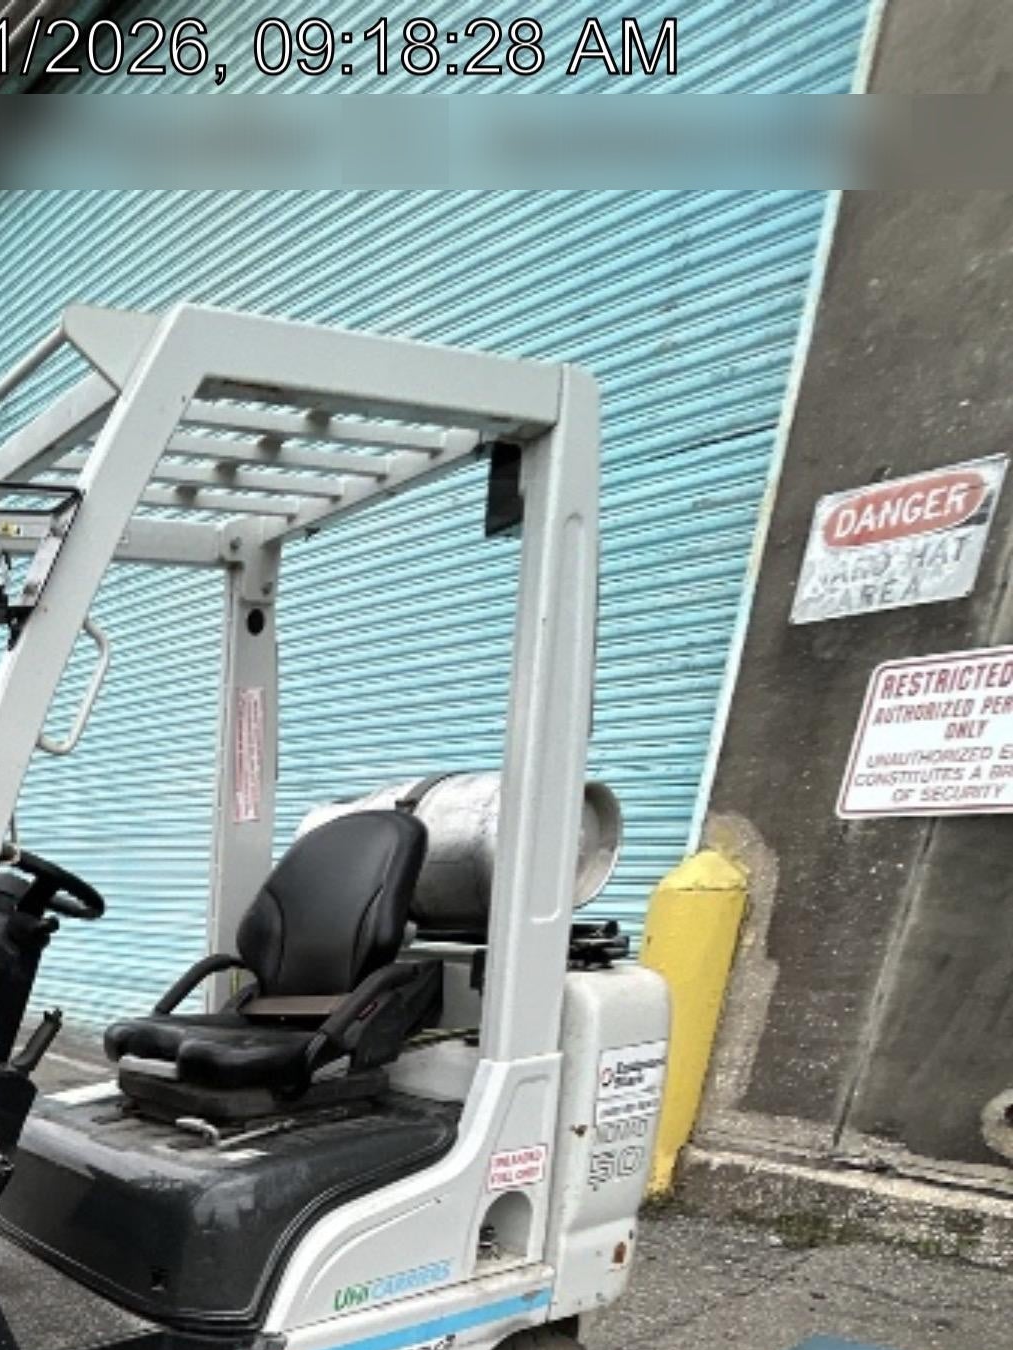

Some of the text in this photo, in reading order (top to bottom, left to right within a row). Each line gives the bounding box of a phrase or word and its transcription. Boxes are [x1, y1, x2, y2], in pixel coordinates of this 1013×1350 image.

[834, 482, 970, 539] DANGER
[881, 660, 1013, 699] RESTRICTED
[873, 698, 976, 725] AUTHORIZED
[944, 719, 989, 741] ONLY
[866, 746, 994, 769] UNAUTHORIZED
[854, 766, 966, 787] CONSTITUTES
[968, 764, 982, 781] A
[891, 783, 1007, 803] OF SECURITY
